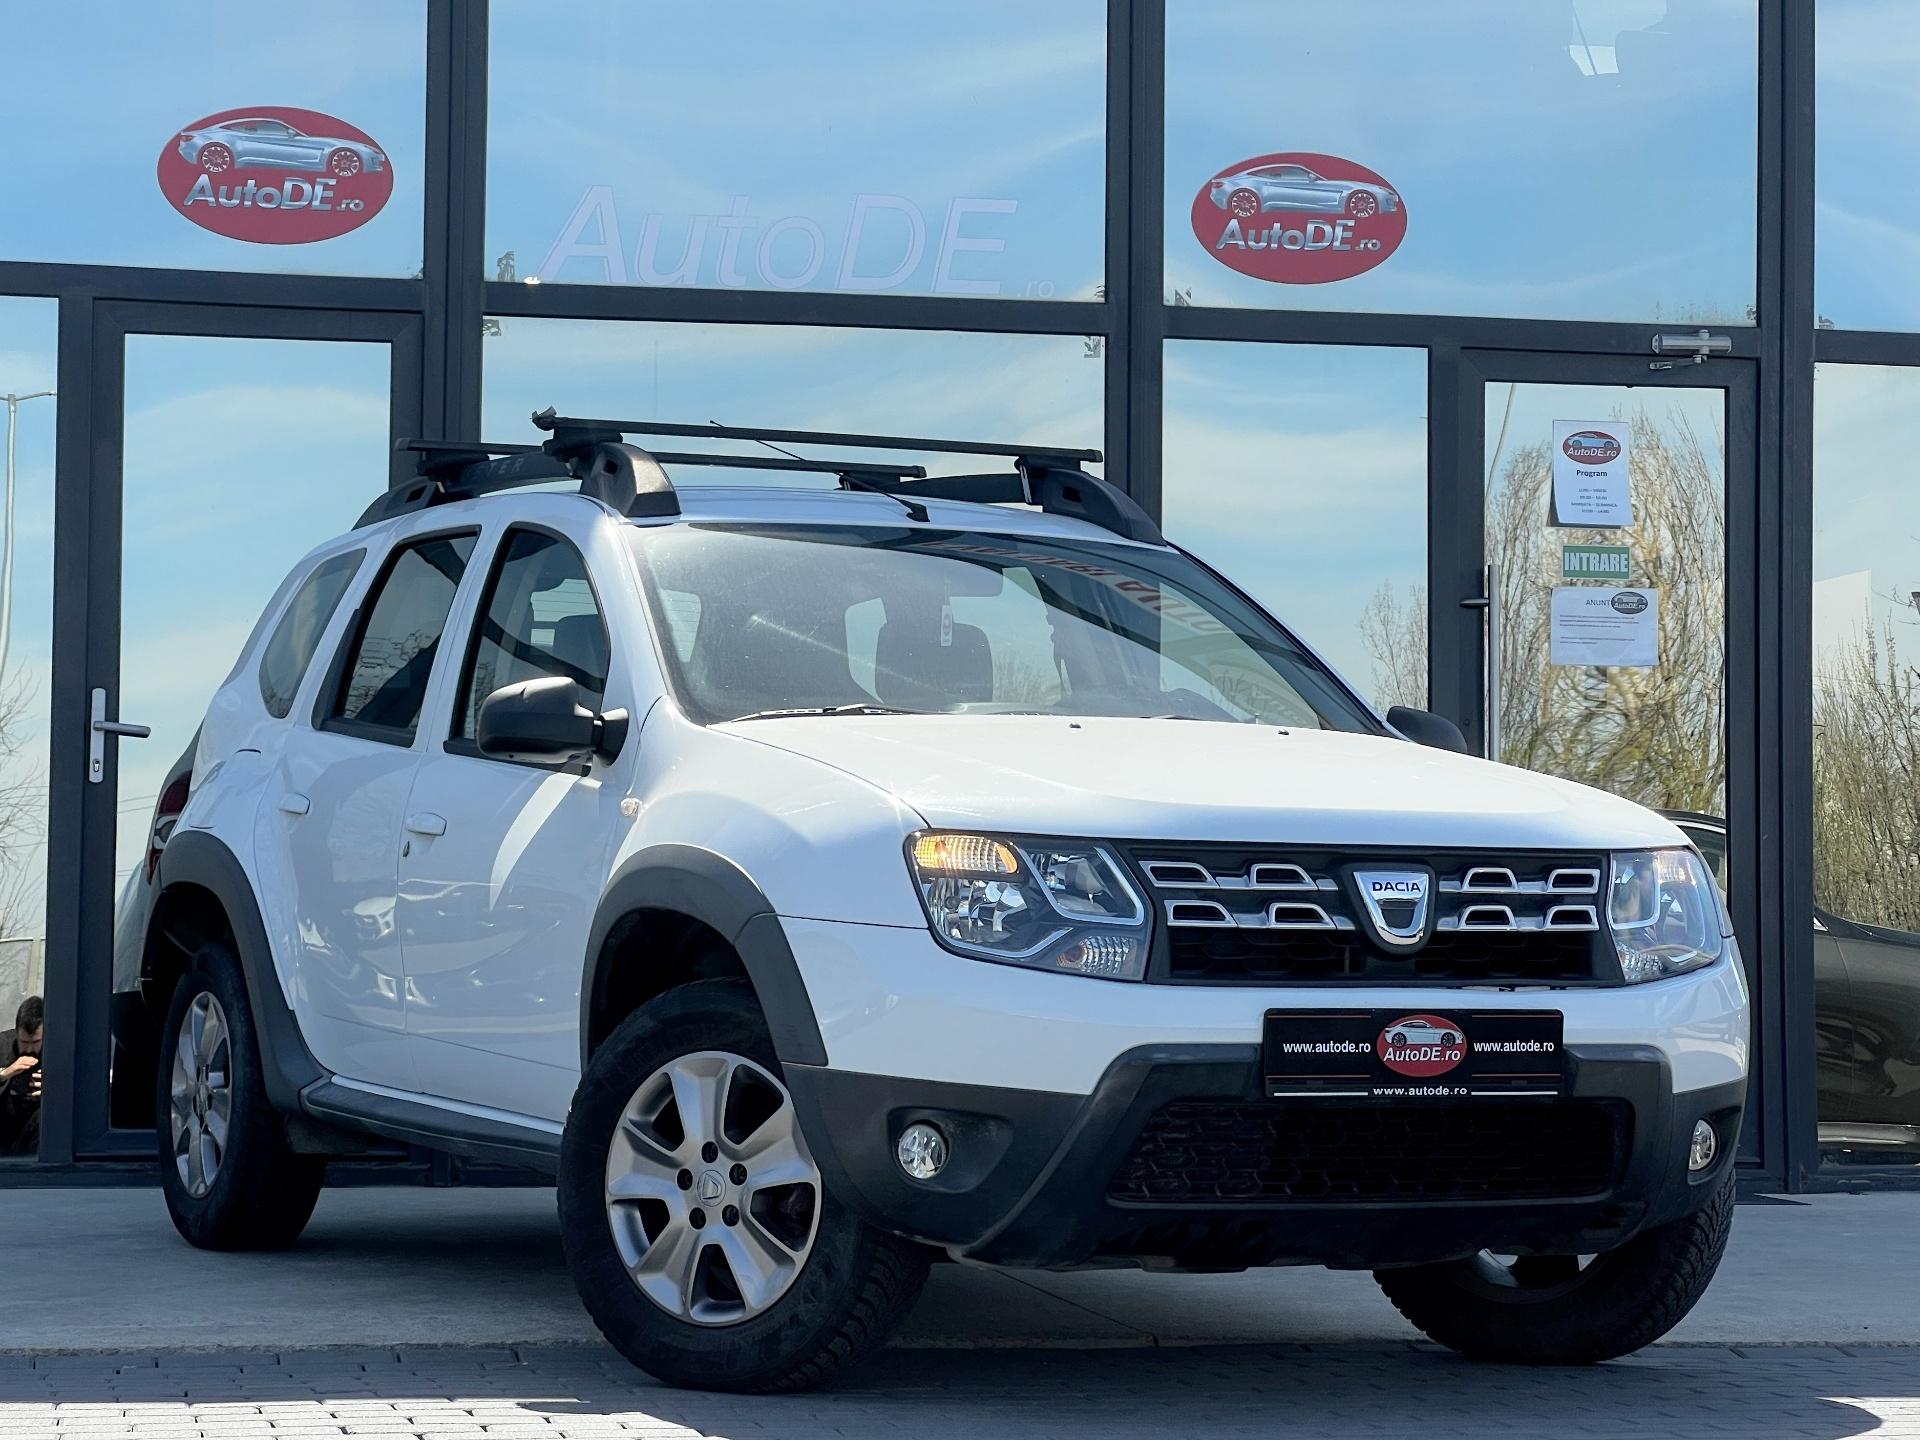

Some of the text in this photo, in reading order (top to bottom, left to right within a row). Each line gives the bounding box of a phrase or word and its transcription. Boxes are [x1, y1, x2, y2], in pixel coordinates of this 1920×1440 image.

[1576, 469, 1608, 477] Program
[1564, 552, 1629, 572] INTRARE
[1371, 881, 1421, 893] DACIA
[1283, 1040, 1371, 1053] www.autode.ro
[1473, 1039, 1555, 1052] www.autode.ro
[1383, 1046, 1461, 1062] AutoDE.ro
[1373, 1085, 1468, 1096] www.autode.ro
